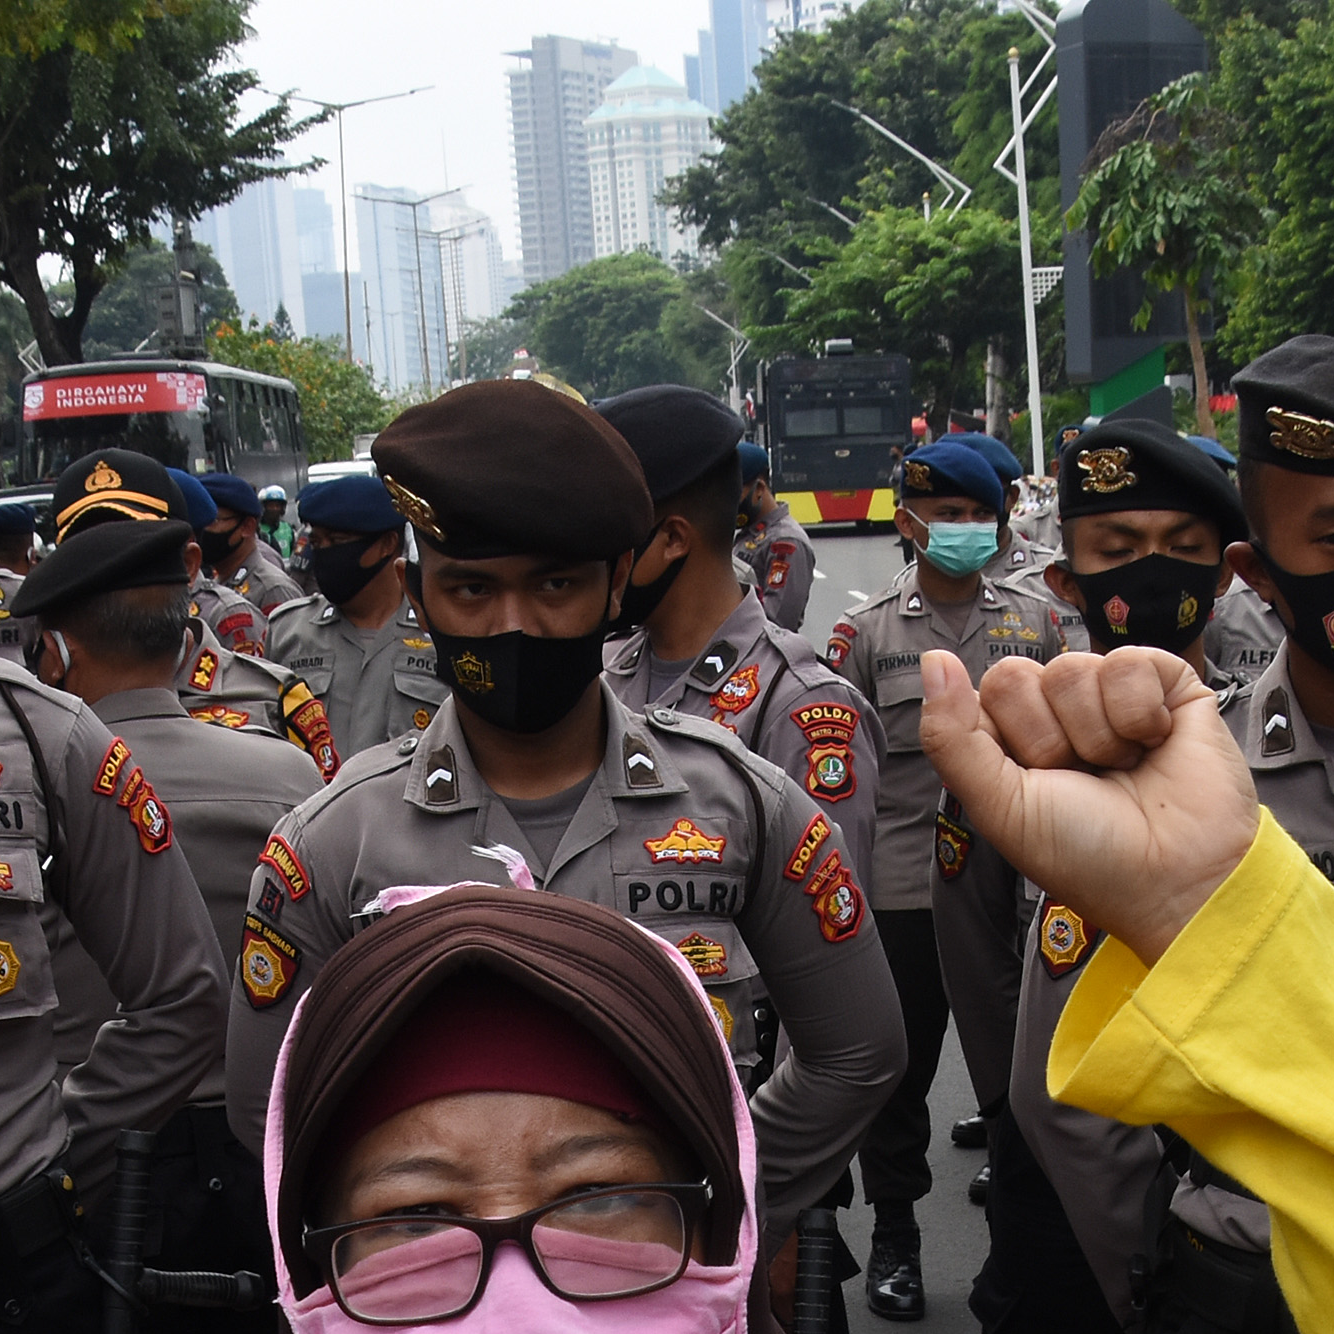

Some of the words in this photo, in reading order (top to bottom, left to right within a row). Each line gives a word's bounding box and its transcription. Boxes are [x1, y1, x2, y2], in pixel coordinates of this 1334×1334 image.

[56, 384, 147, 398] DIRGAHAYU
[57, 394, 145, 408] INDONESIA
[876, 653, 920, 673] FIRMAN
[800, 706, 854, 723] POLDA
[100, 742, 129, 790] POLDA
[791, 820, 828, 875] POLDA
[628, 880, 738, 914] POLRI
